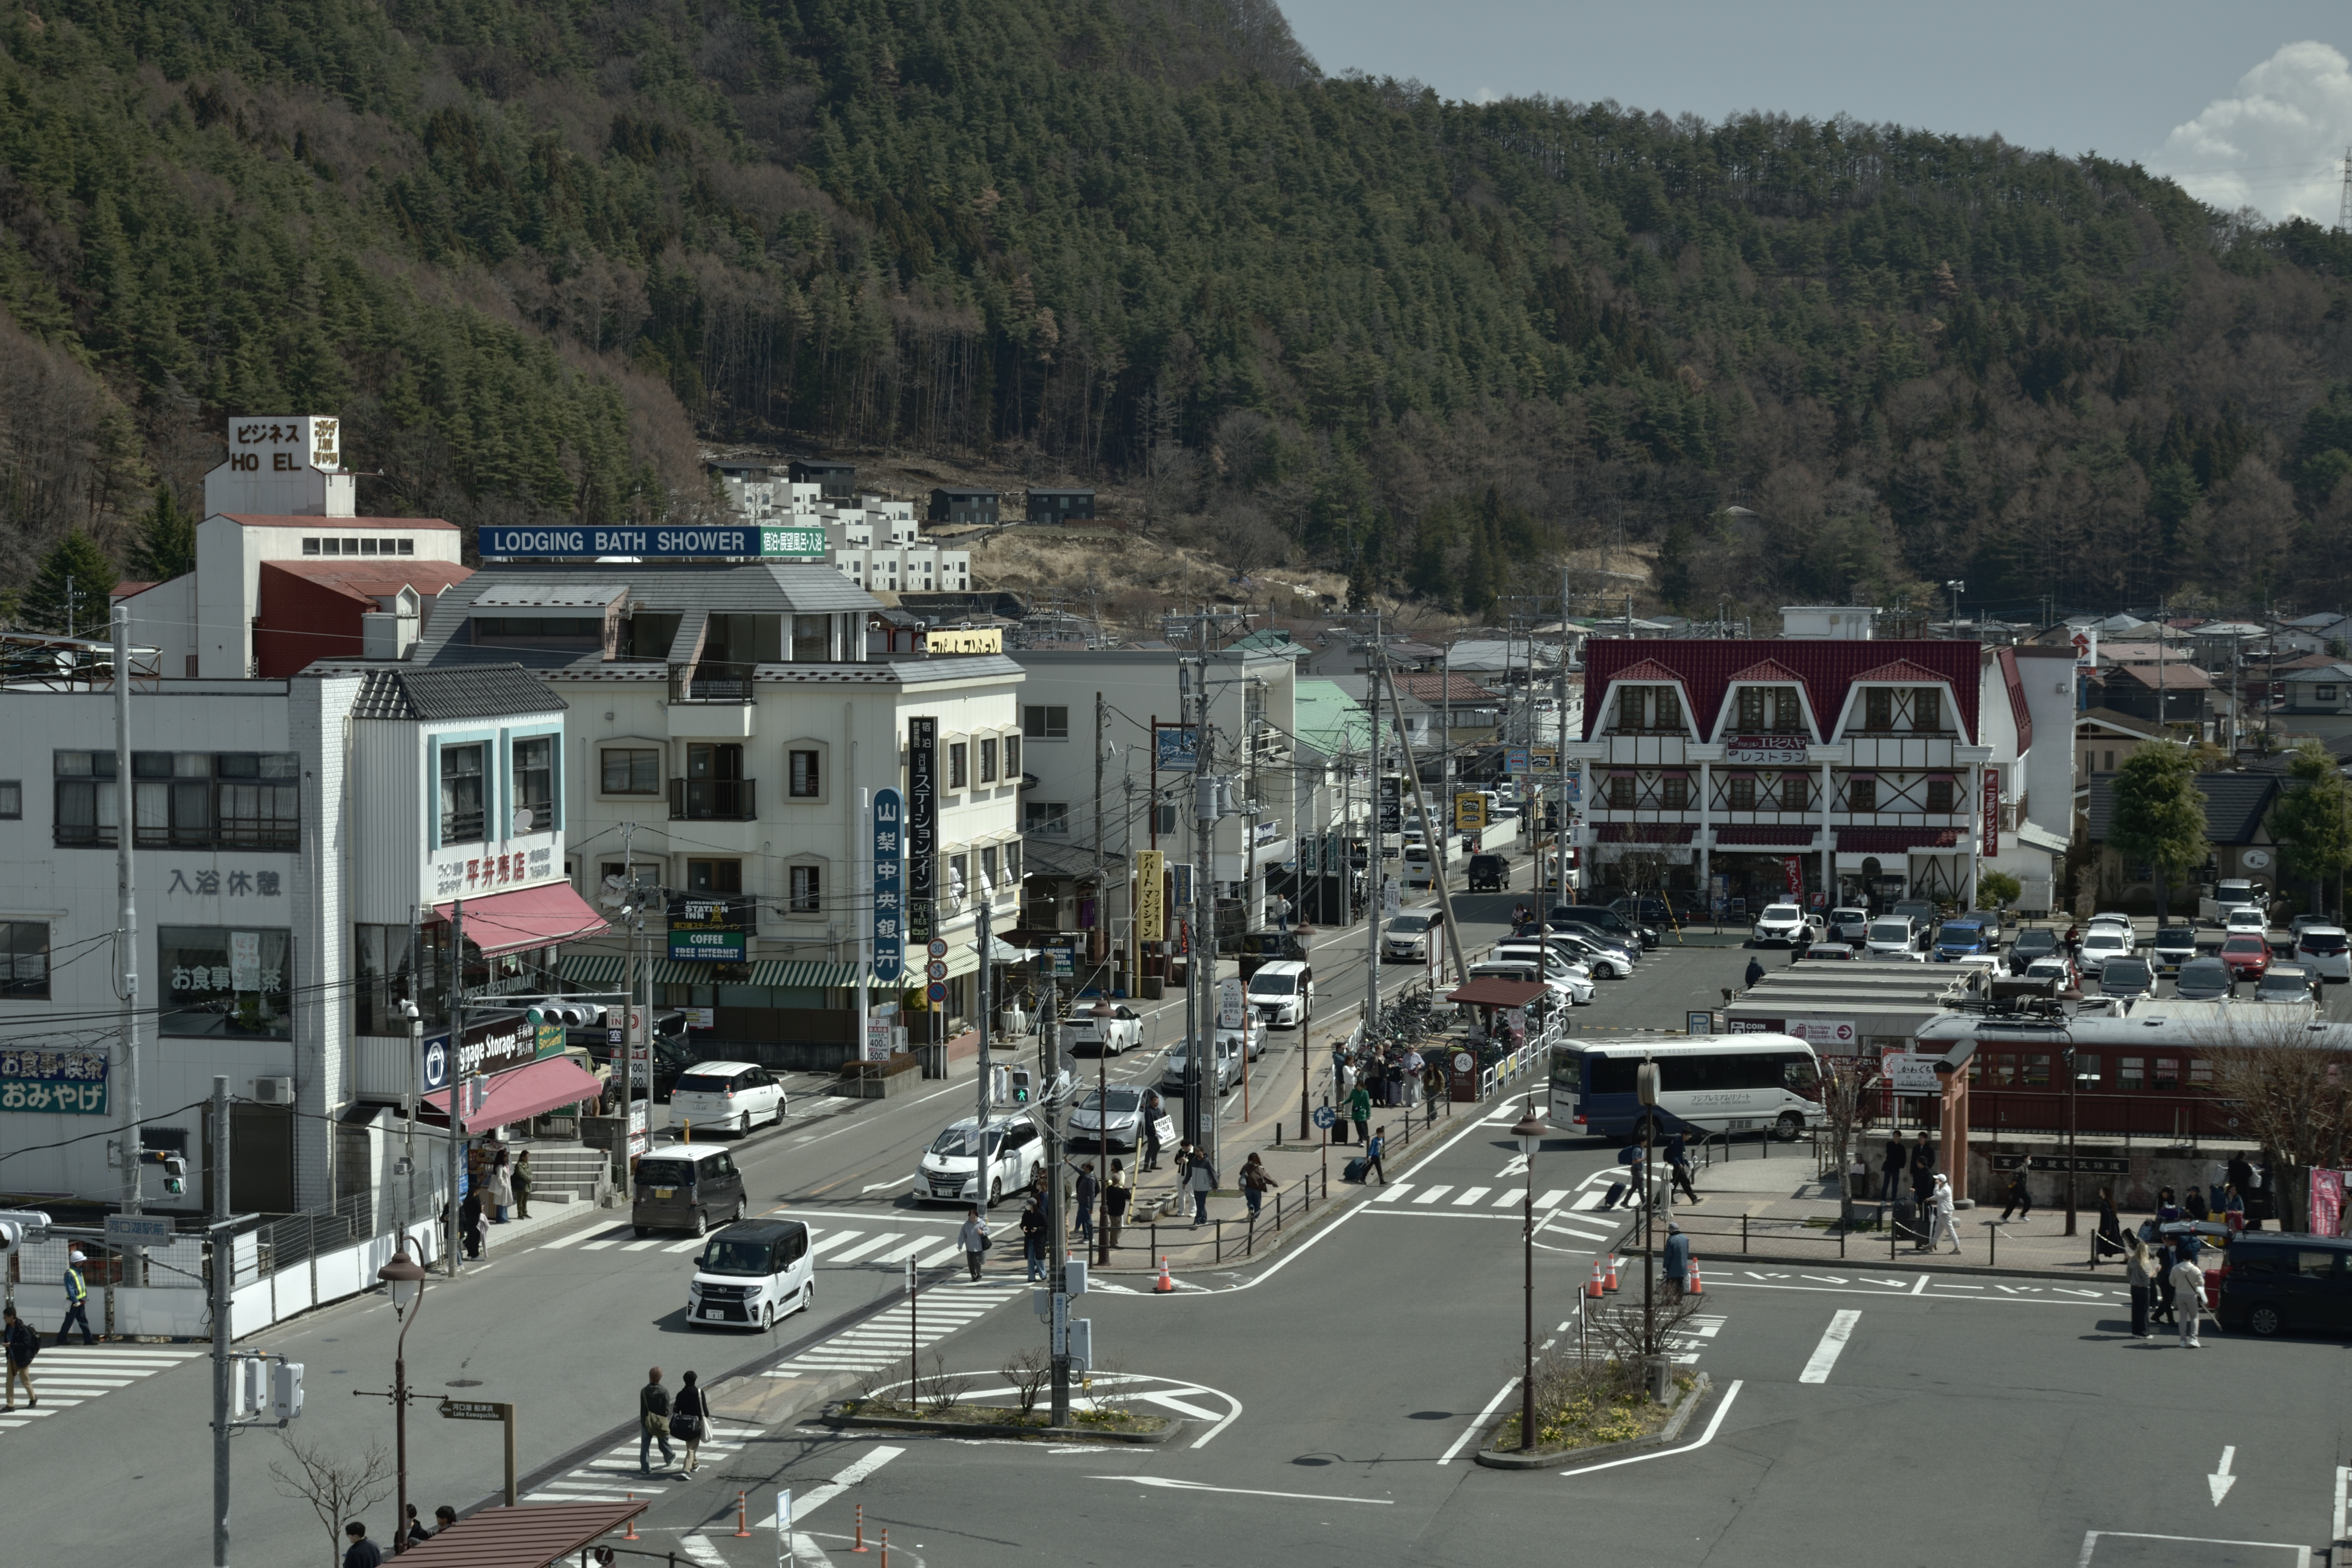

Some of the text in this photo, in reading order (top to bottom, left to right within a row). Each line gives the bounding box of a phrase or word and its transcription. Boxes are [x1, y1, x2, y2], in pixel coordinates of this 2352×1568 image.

[238, 424, 299, 444] ビジネス
[315, 419, 338, 437] プラザ
[495, 531, 745, 551] LODGING BATH SHOWER
[763, 531, 822, 552] 宿泊・展望風呂・入浴
[922, 721, 931, 748] 宿泊
[1759, 737, 1806, 749] エビスヤ
[1741, 752, 1805, 762] レストラン
[1986, 788, 1996, 852] ニッポンレンタカー
[466, 851, 525, 889] 平井売店
[1143, 854, 1154, 887] アパート
[167, 869, 281, 897] 入浴休憩
[876, 803, 899, 968] 山梨中央銀行
[1143, 890, 1153, 937] マンション
[690, 934, 724, 944] COFFEE
[675, 947, 739, 958] FREE INTERNET
[931, 944, 945, 953] 30
[487, 972, 536, 997] RESTAURANT
[881, 1006, 893, 1016] BANK
[516, 1024, 534, 1040] 手荷物
[1690, 1015, 1709, 1034] P
[1695, 1026, 1707, 1034] 入口
[539, 1034, 562, 1050] Souvenir
[610, 1029, 621, 1042] 空
[486, 1033, 515, 1059] Storage
[516, 1040, 534, 1057] 預り所
[613, 1049, 645, 1059] 最料金
[1901, 1065, 1931, 1073] かわぐち
[2, 1082, 103, 1110] おみやげ
[1691, 1093, 1750, 1102] フジプレミアムリゾート
[1154, 1116, 1171, 1129] PRIVATE
[1161, 1124, 1171, 1132] OUR
[2001, 1159, 2120, 1170] 富山麓電気鉄道
[109, 1220, 164, 1236] 河口湖駅前
[474, 1404, 493, 1412] 船津浜
[599, 1547, 609, 1560] 7
